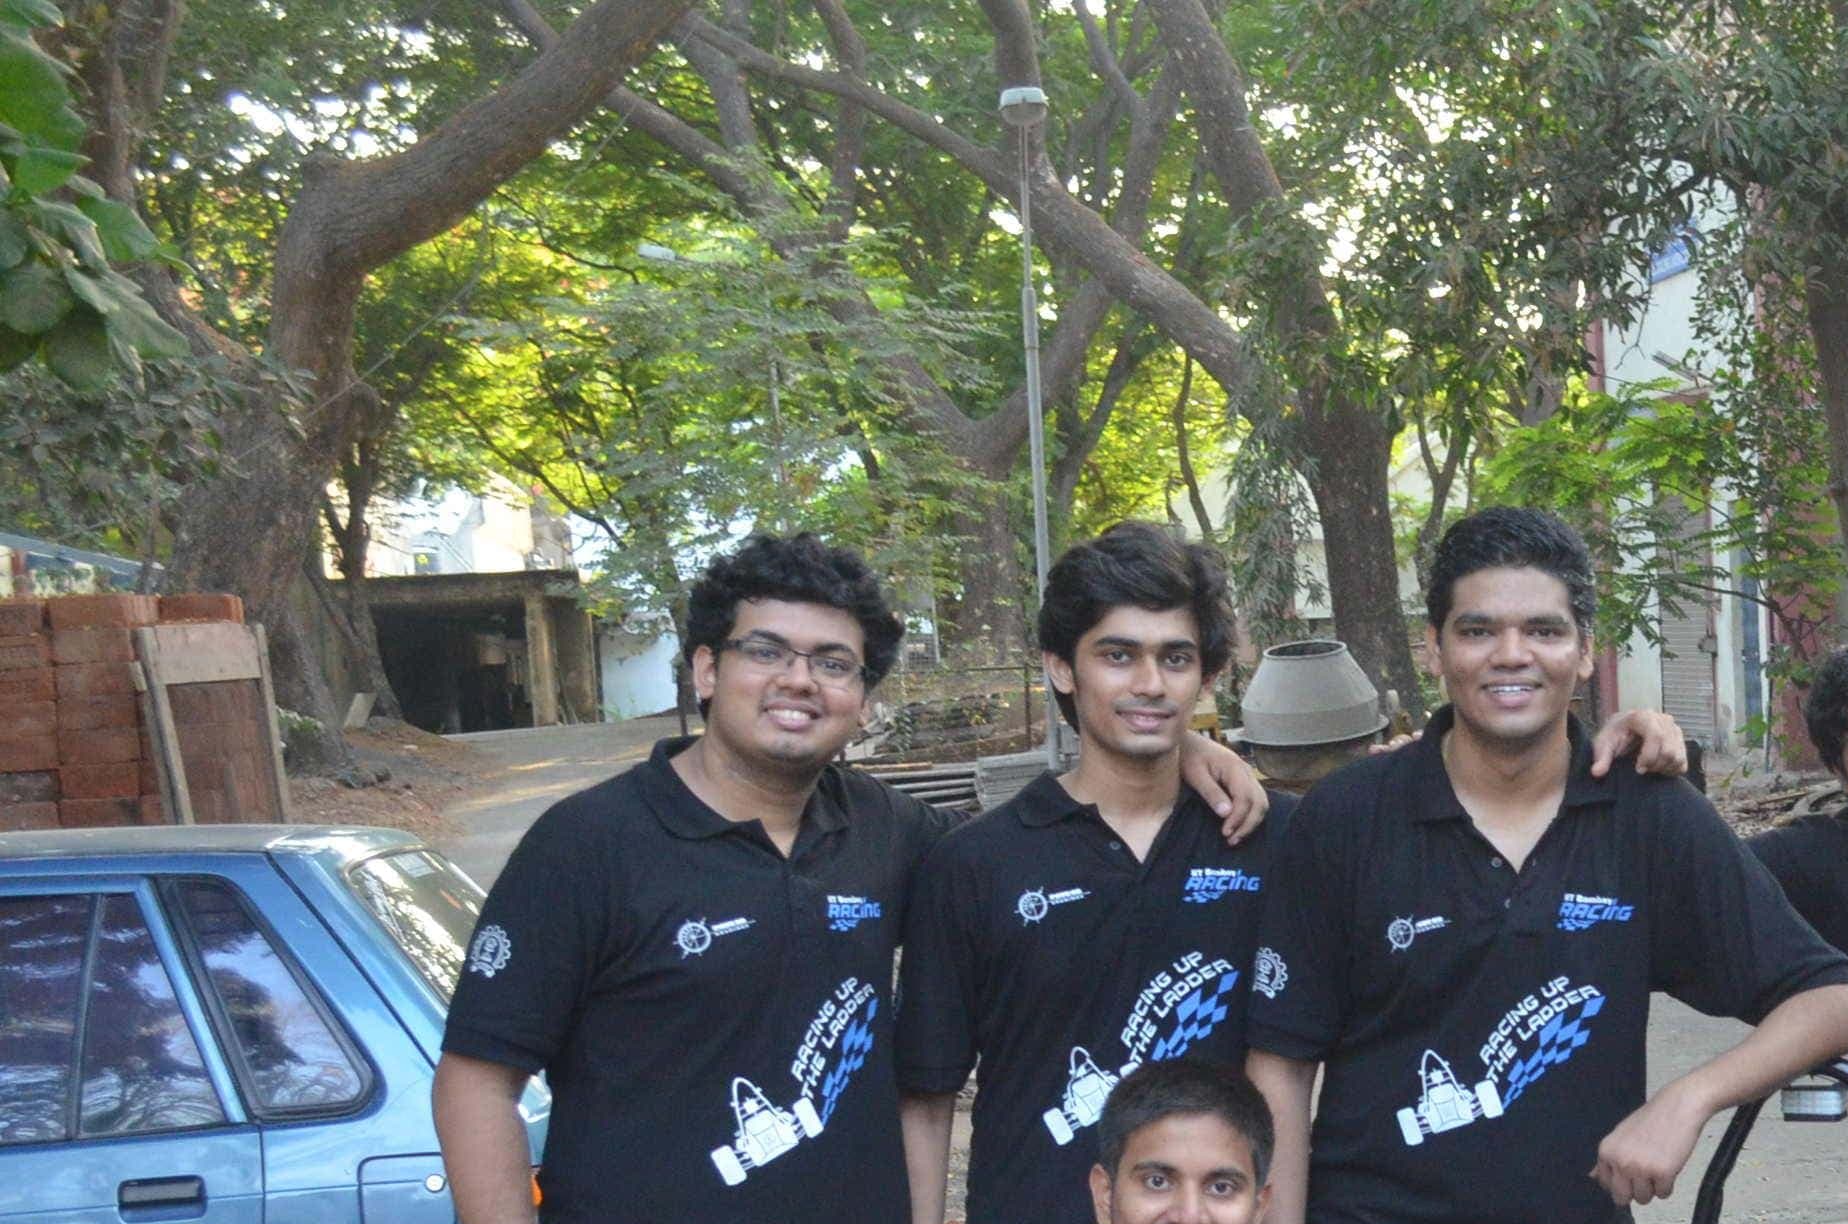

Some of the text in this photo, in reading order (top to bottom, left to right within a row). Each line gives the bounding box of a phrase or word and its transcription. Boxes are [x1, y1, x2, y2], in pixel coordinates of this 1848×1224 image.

[791, 977, 858, 1081] RACING UP
[801, 983, 875, 1099] THE LADDER
[1120, 951, 1203, 1048] RACING UP
[1130, 959, 1233, 1066] THE LADDER
[1480, 976, 1569, 1065] RACING UP
[1486, 985, 1600, 1083] THE LADDER
